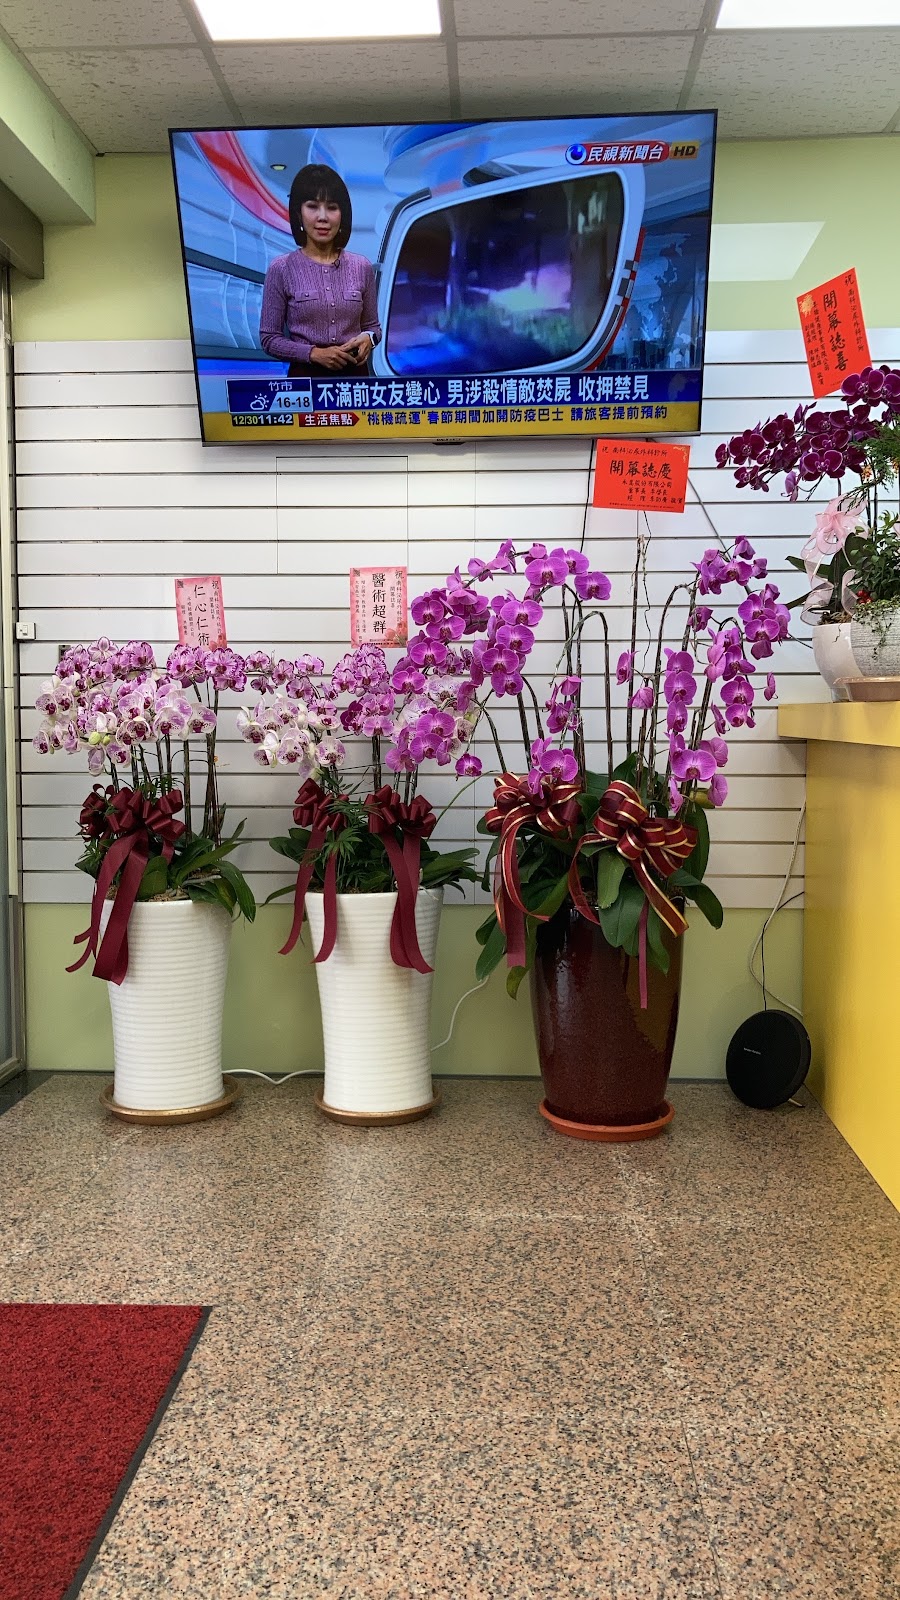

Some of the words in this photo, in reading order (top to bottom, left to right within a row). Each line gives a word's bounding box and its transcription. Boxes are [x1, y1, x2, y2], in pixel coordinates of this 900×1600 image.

[587, 144, 663, 162] 民視新聞台
[674, 145, 696, 157] HD
[845, 274, 854, 286] 祝
[823, 290, 848, 371] 開幕誌喜
[268, 381, 292, 391] 竹市
[317, 381, 440, 408] 不滿前女友變心
[448, 377, 571, 405] 男涉殺情敵焚屍
[578, 375, 650, 401] 收押禁見
[276, 397, 310, 408] 16-18
[233, 415, 258, 425] 12/30
[258, 414, 293, 424] 11:42
[304, 414, 353, 426] 生活焦點
[571, 406, 668, 421] 請旅客提前預約
[610, 460, 672, 480] 開幕誌慶
[372, 573, 387, 634] 醫術超群
[194, 584, 210, 646] 仁心仁術
